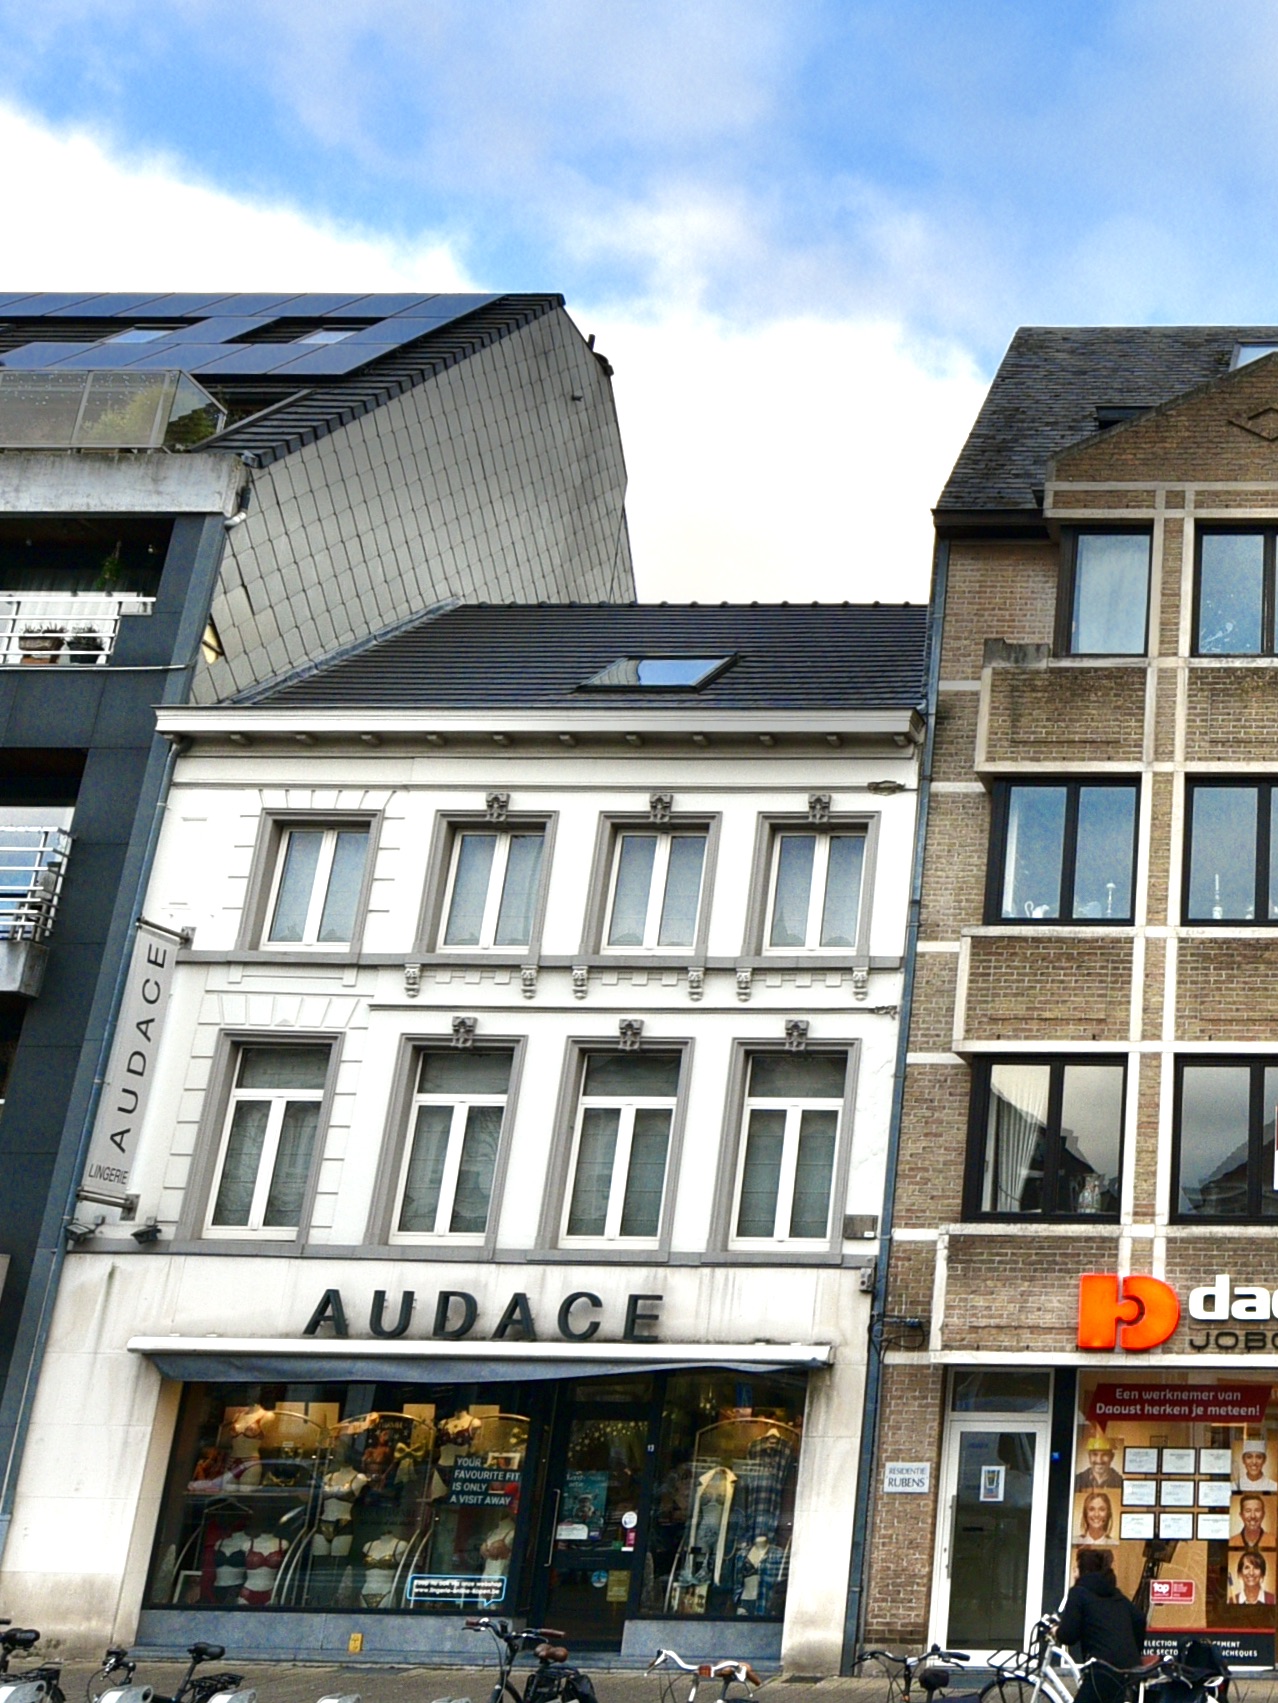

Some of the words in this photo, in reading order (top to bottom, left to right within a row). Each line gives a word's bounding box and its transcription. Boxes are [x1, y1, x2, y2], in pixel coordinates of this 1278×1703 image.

[109, 943, 168, 1154] AUDACE
[88, 1162, 129, 1185] LINGERIE
[302, 1288, 664, 1343] AUDACE
[1115, 1388, 1139, 1400] Een
[1142, 1388, 1215, 1401] werknemer
[1217, 1390, 1241, 1401] van
[1096, 1402, 1141, 1415] Daoust
[1144, 1403, 1189, 1415] herken
[1191, 1404, 1204, 1417] je
[1207, 1404, 1260, 1416] meteen!
[457, 1457, 482, 1467] YOUR
[454, 1470, 504, 1480] FAVOURITE
[505, 1471, 521, 1481] FIT
[888, 1467, 926, 1476] RESIDENTIE
[452, 1481, 462, 1491] IS
[463, 1482, 488, 1492] ONLY
[449, 1494, 457, 1503] A
[459, 1494, 484, 1504] VISIT
[484, 1495, 512, 1506] AWAY
